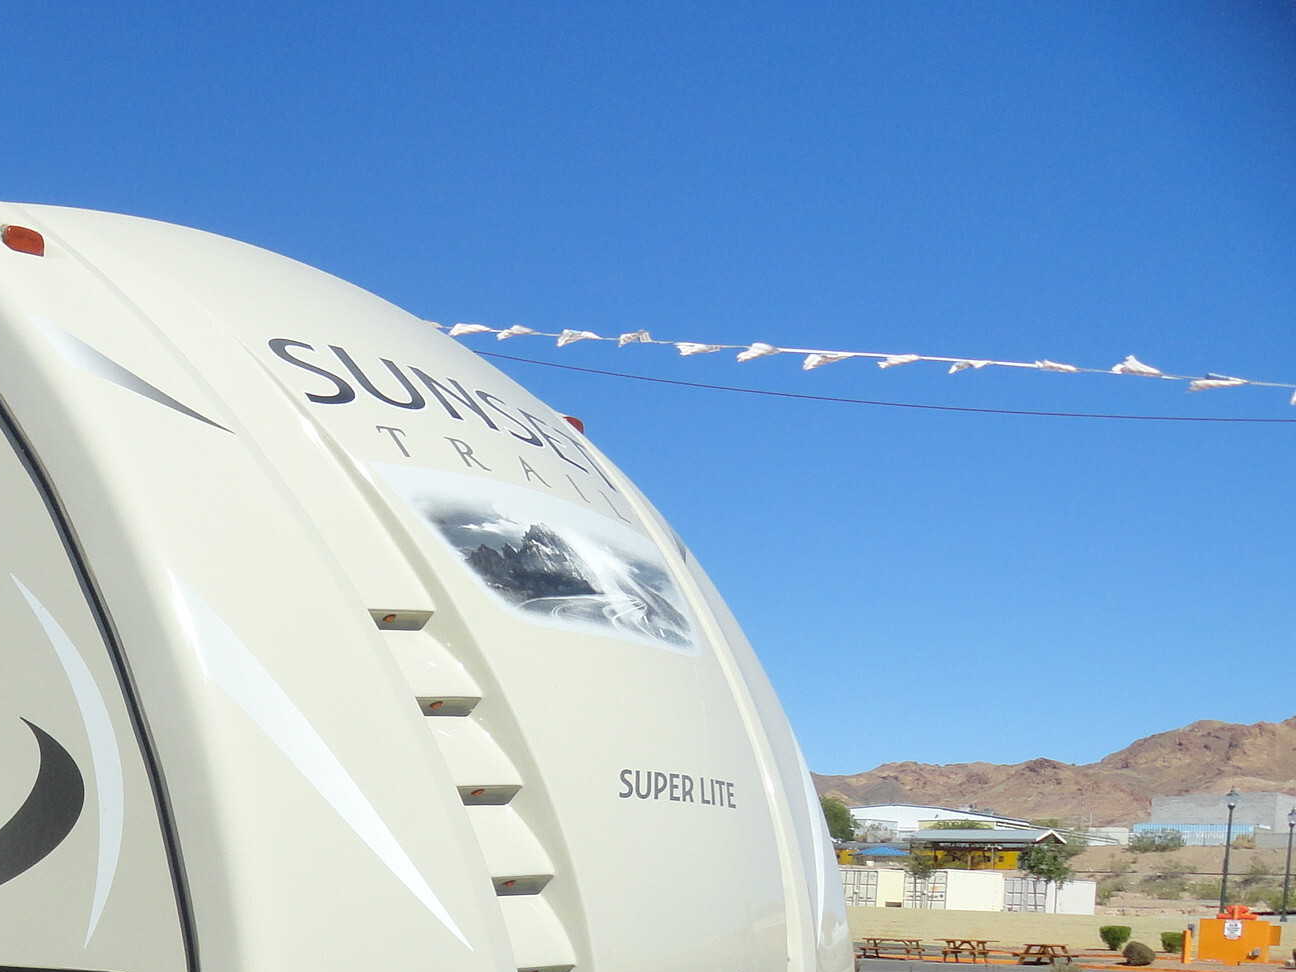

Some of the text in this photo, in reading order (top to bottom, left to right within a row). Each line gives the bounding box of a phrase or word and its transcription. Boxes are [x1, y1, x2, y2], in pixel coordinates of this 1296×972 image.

[268, 338, 618, 492] SUNSET
[376, 425, 630, 522] TRAIL
[619, 769, 736, 809] SUPER LITE
